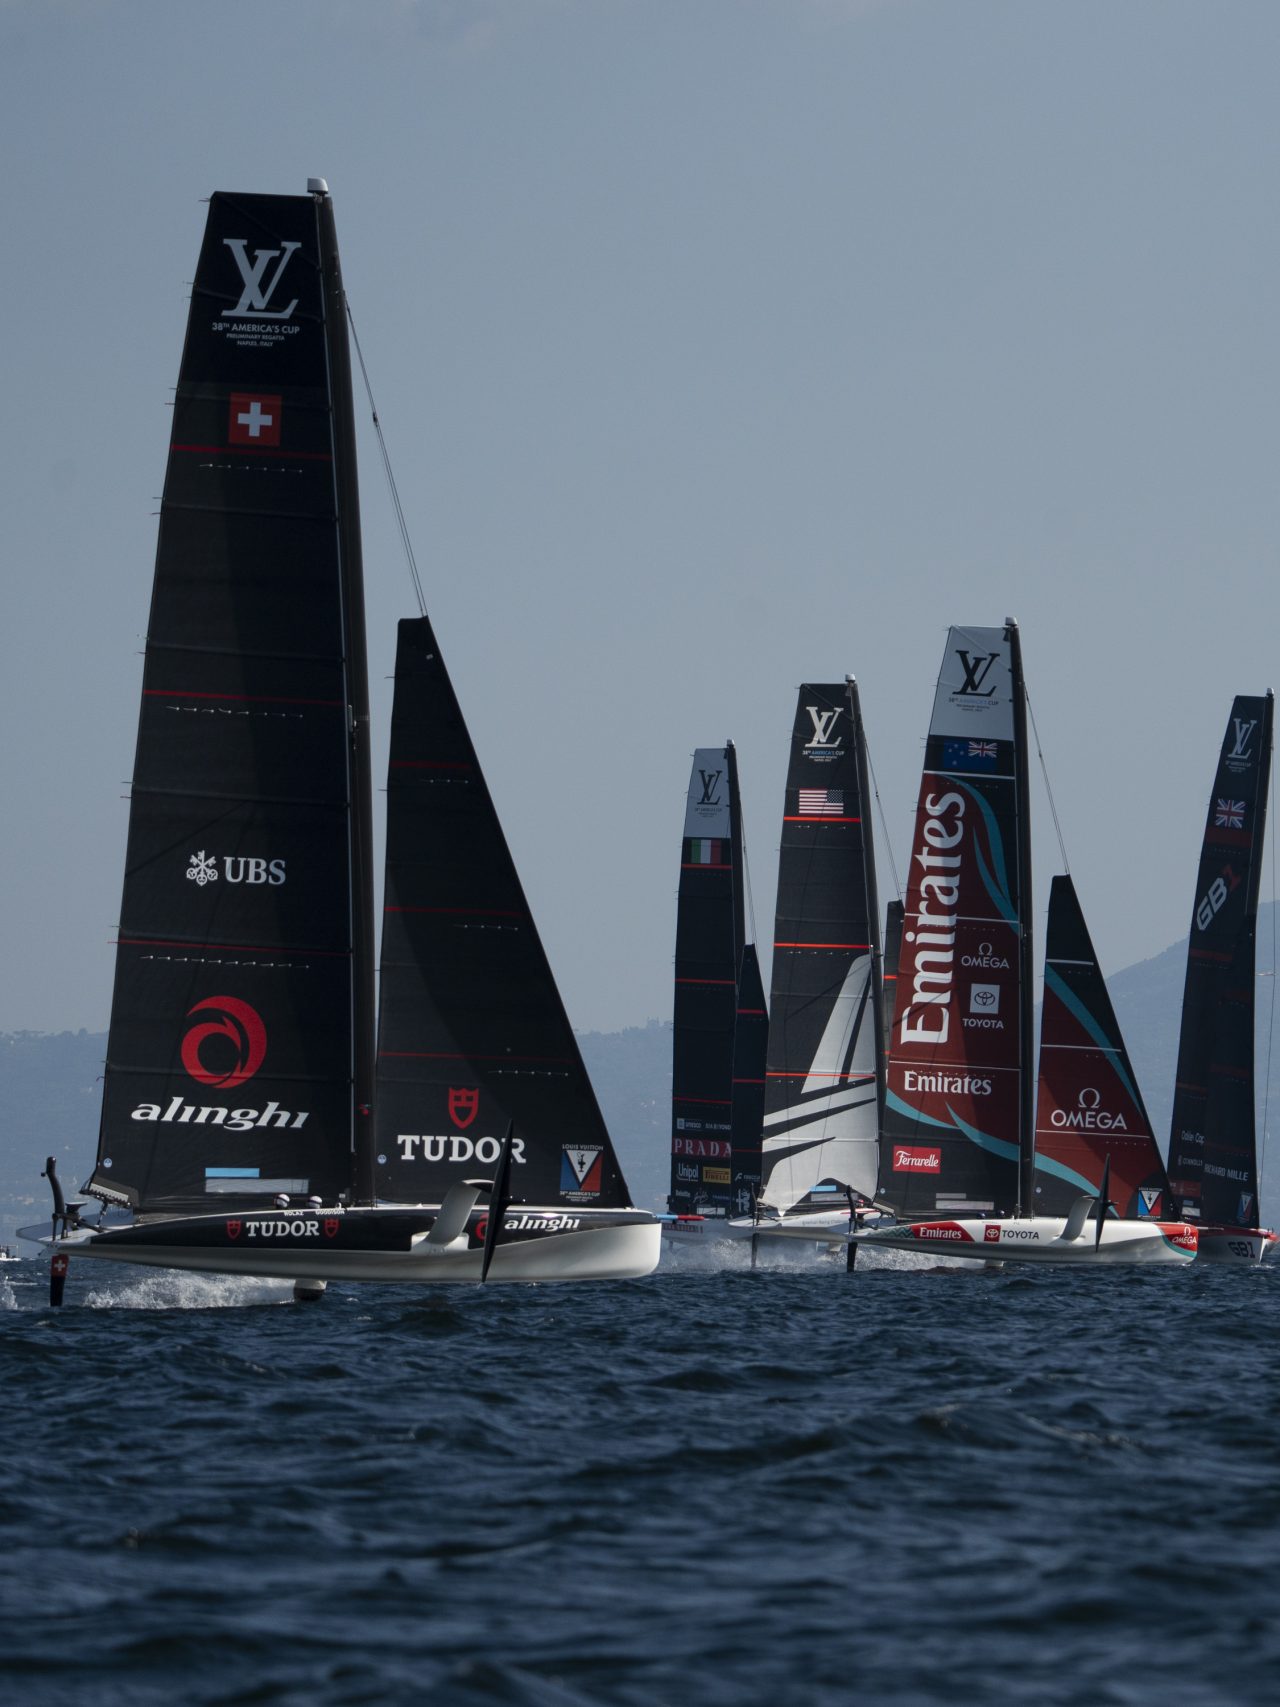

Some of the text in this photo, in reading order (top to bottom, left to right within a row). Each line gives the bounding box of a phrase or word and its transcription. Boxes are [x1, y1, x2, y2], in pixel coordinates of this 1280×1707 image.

[231, 323, 280, 333] AMERICA'S
[281, 325, 300, 335] CUP
[224, 856, 286, 885] UBS
[901, 791, 966, 1045] Emirates
[961, 955, 1010, 969] OMEGA
[962, 1018, 1004, 1029] TOYOTA
[904, 1070, 992, 1096] Emirates
[131, 1096, 310, 1131] alinghi
[1051, 1109, 1128, 1131] OMEGA
[397, 1134, 527, 1164] TUDOR
[674, 1138, 731, 1157] PRADA
[895, 1150, 939, 1168] Ferrarelle
[1227, 1169, 1249, 1182] MILLE
[246, 1221, 320, 1237] TUDOR
[504, 1214, 581, 1232] alinghi
[919, 1227, 962, 1239] Emirates
[1002, 1230, 1039, 1240] TOYOTA
[1172, 1236, 1198, 1244] OMEGA
